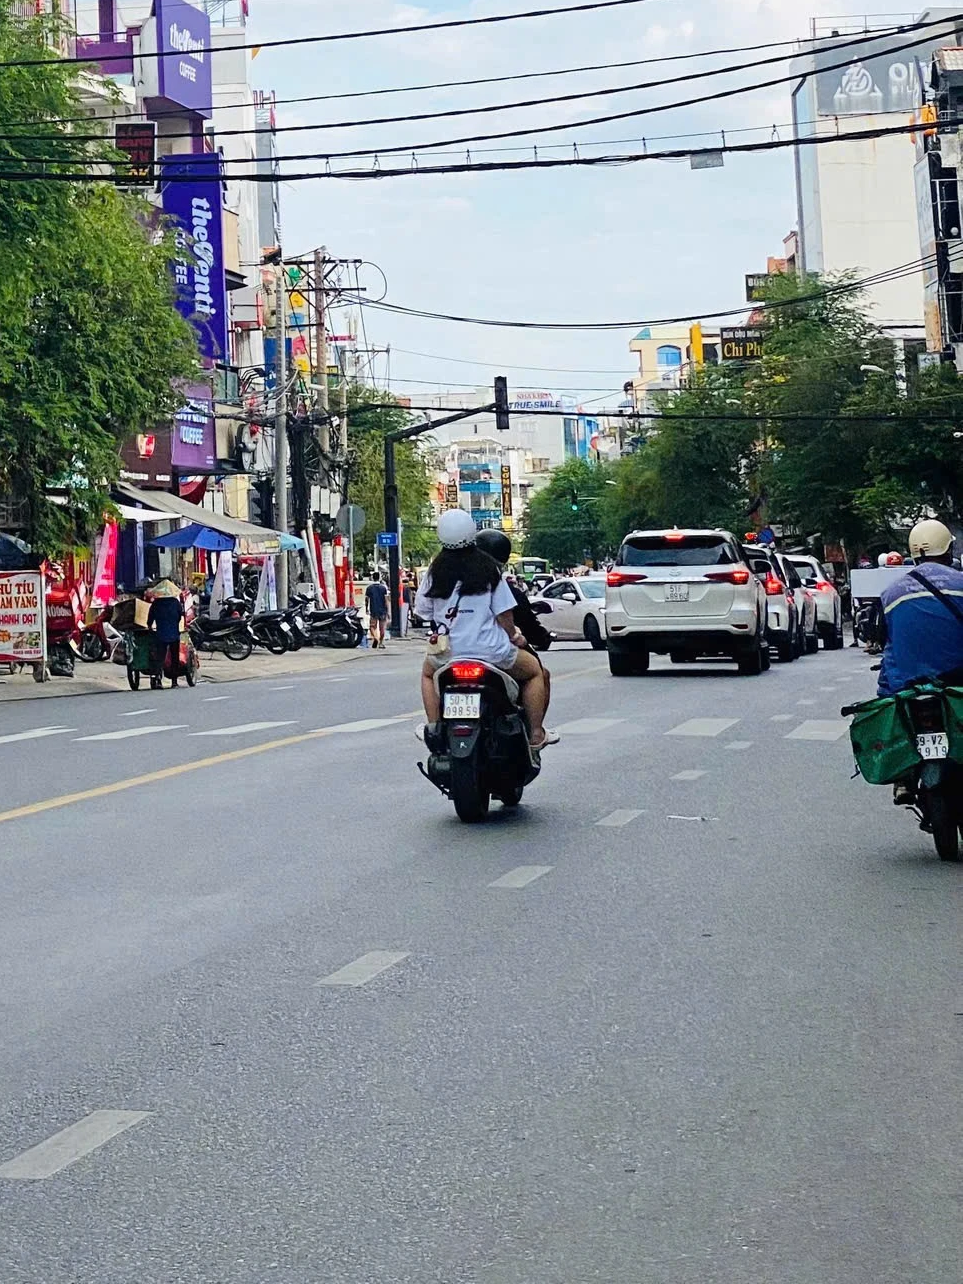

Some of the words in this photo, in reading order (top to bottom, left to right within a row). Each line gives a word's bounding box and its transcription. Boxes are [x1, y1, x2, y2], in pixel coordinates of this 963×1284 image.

[180, 61, 196, 82] COFFEE
[746, 341, 763, 356] Ph
[508, 401, 531, 409] TRUE
[534, 400, 560, 409] SMILE
[15, 580, 34, 594] TÍU
